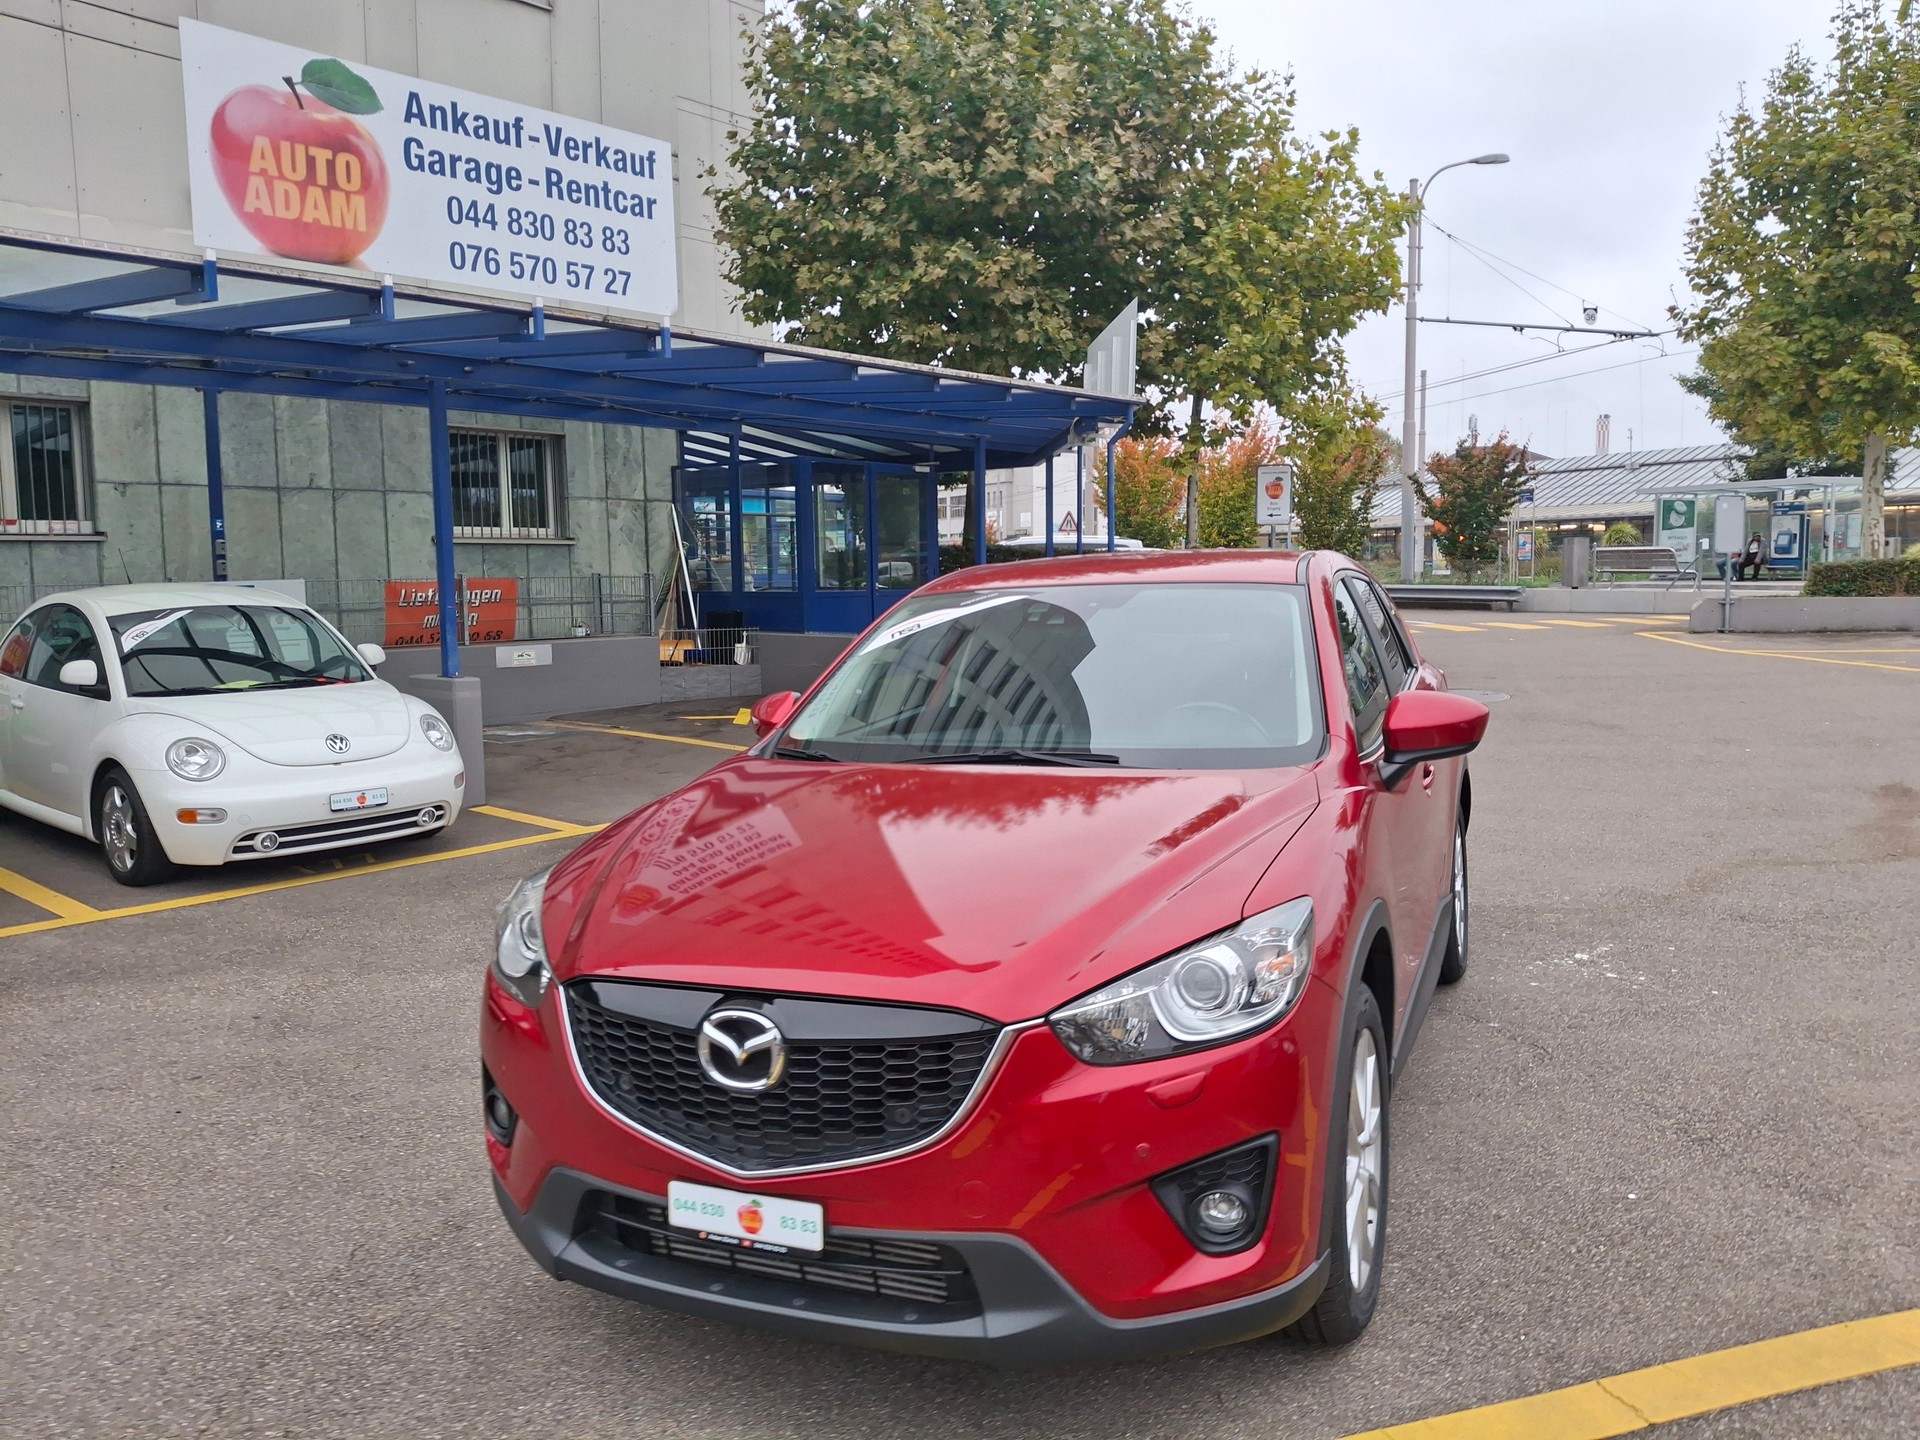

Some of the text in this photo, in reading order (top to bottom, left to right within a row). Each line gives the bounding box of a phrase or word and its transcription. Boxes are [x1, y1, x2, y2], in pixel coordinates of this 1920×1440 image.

[248, 135, 362, 192] AUTO
[404, 91, 657, 180] Ankauf-Verkauf
[244, 175, 367, 231] ADAM
[404, 137, 658, 220] Garage-Rentcar
[446, 195, 630, 256] 044 830 83 83
[449, 241, 632, 296] 076 570 57 27
[673, 1197, 818, 1234] 044 830 83 83
